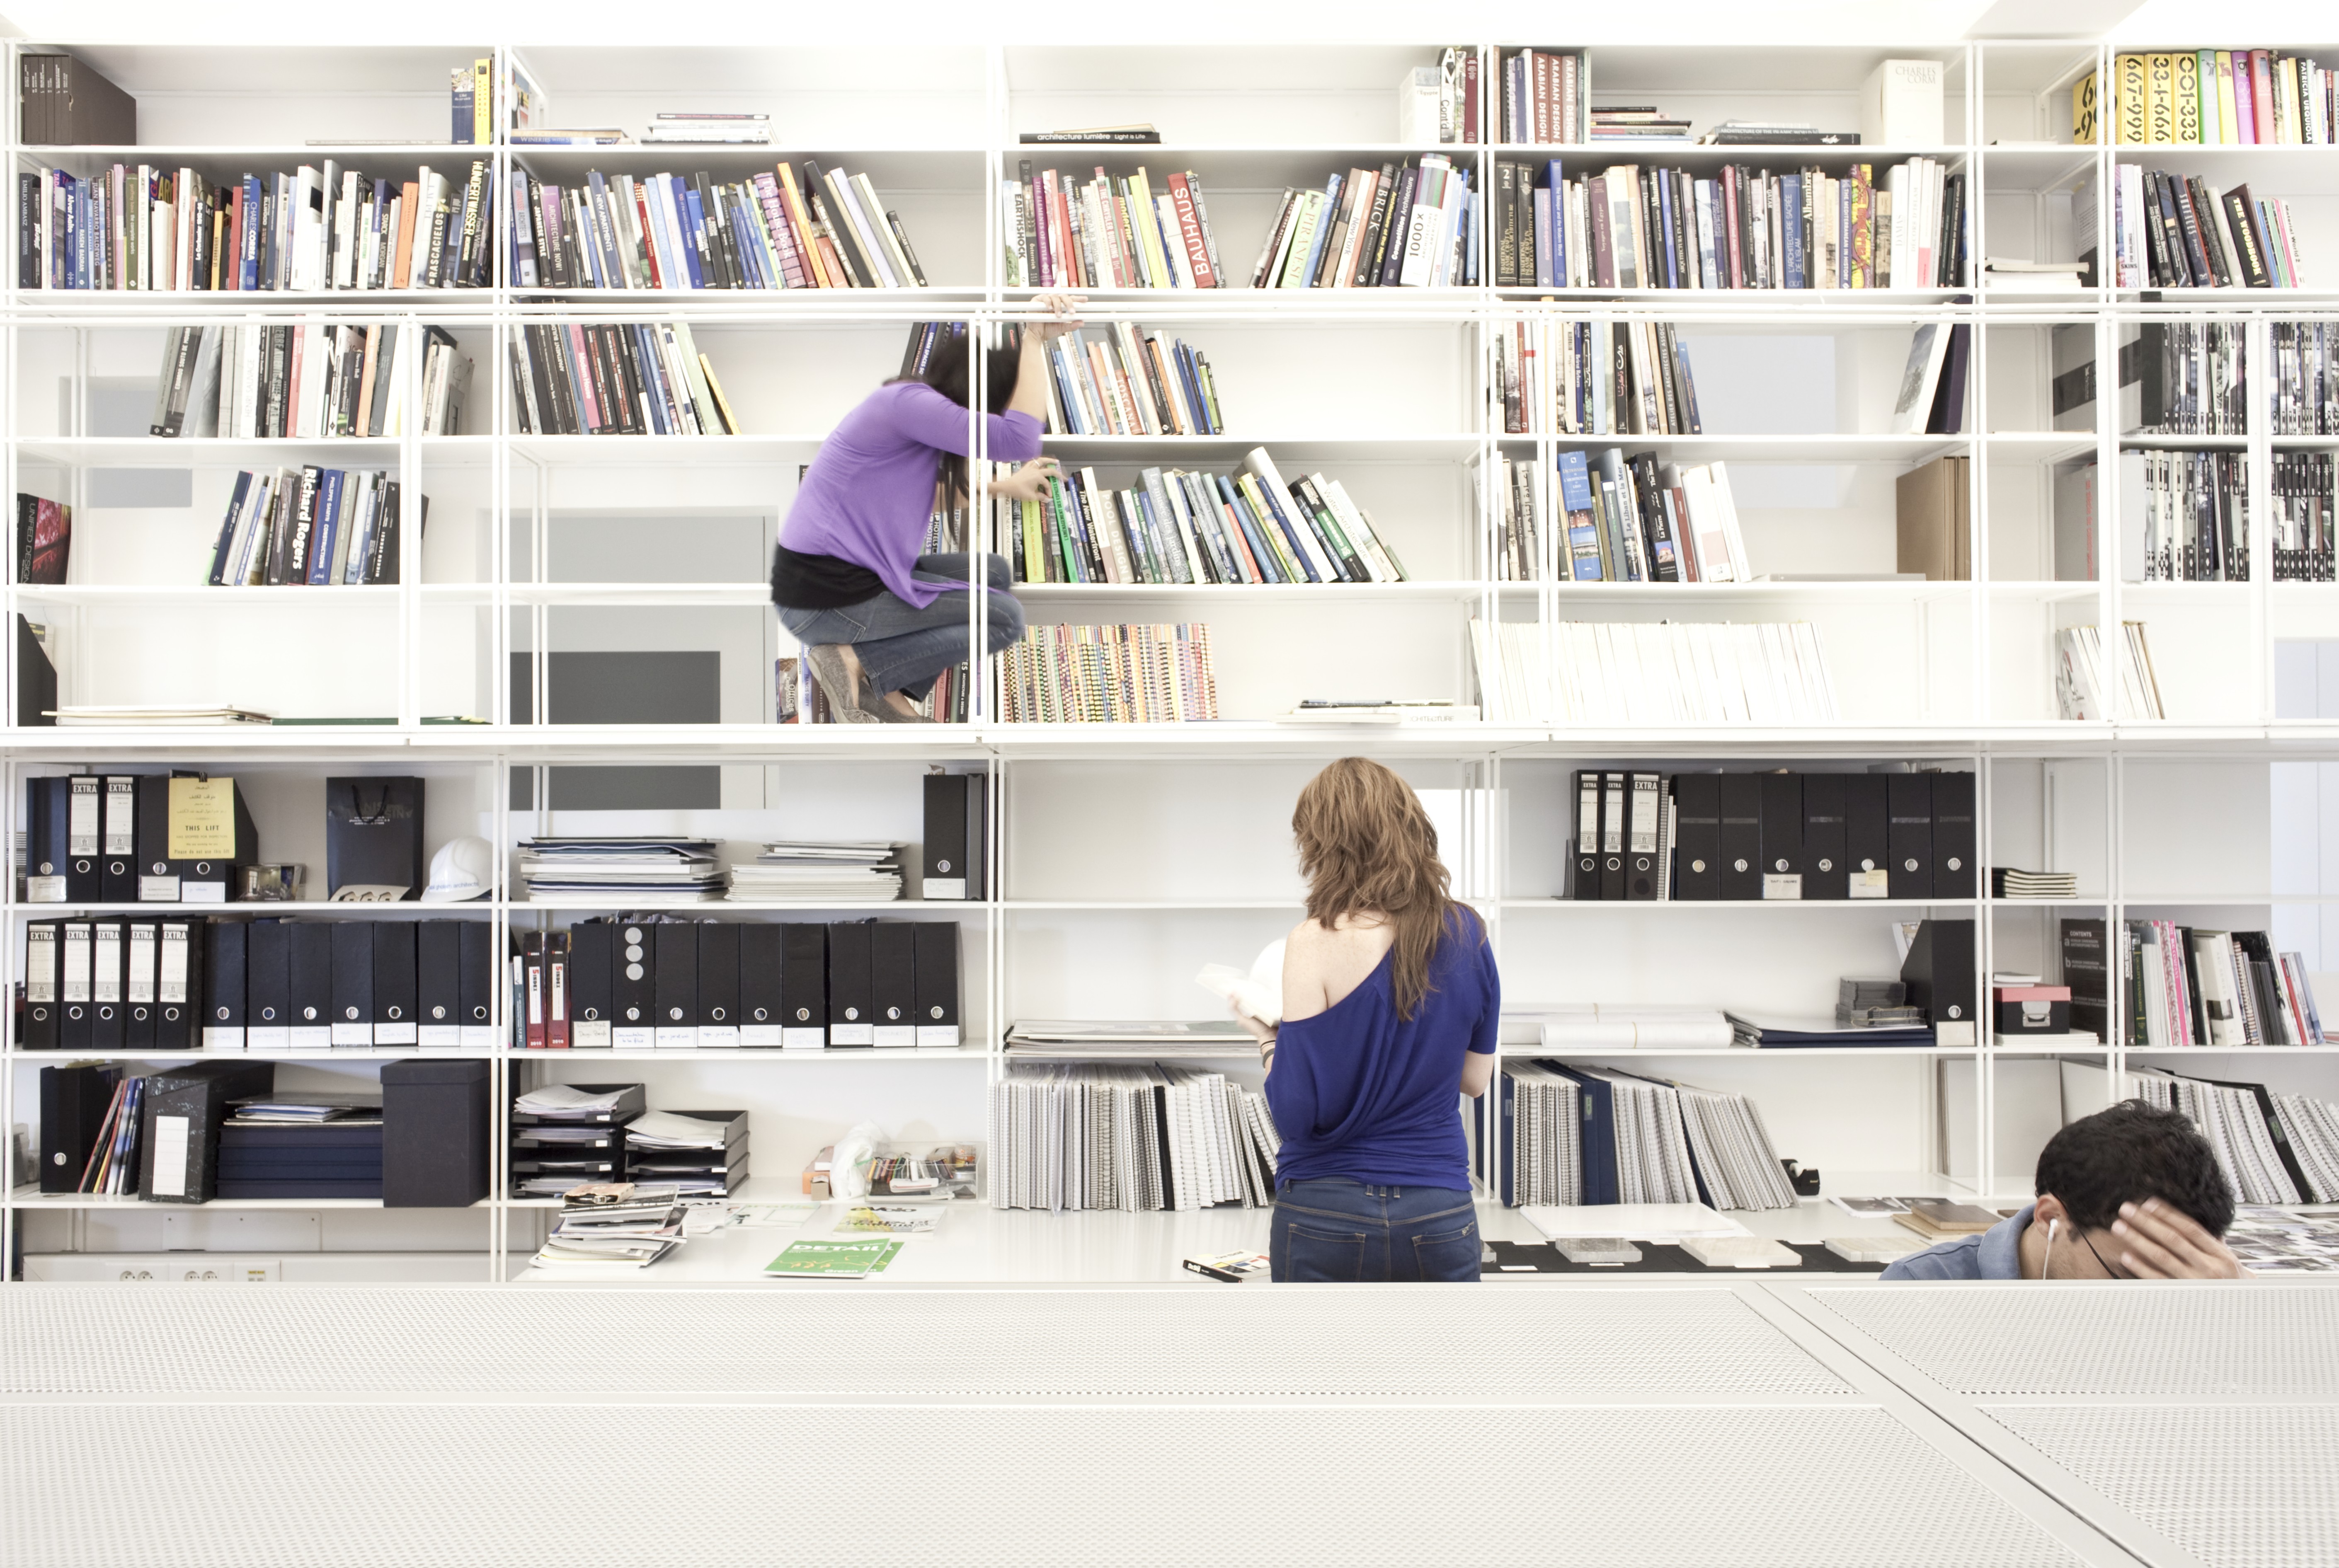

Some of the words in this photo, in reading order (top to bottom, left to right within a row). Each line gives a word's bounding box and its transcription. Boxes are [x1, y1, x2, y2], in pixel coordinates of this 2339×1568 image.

[1895, 66, 1936, 75] CHARLES
[1908, 75, 1936, 84] CORM
[2126, 58, 2143, 142] 667-999
[2153, 57, 2170, 141] 334-666
[2179, 57, 2197, 140] 001-333
[1539, 102, 1547, 137] DESIGN
[2303, 99, 2312, 142] URQUIOLA
[464, 161, 484, 235] HUNDERTWASSER
[595, 194, 604, 210] NEW
[1099, 188, 1108, 199] THE
[1369, 189, 1388, 231] BRICK
[1384, 191, 1397, 229] Architecture
[1650, 172, 1660, 208] Alhambra
[1802, 172, 1812, 221] Alhambra
[534, 206, 544, 237] JAPANESE
[599, 211, 613, 252] APARTMENTS
[763, 177, 774, 198] The
[771, 199, 784, 231] House
[779, 233, 793, 259] Book
[1015, 194, 1026, 259] EARTHSHOCK
[1036, 196, 1045, 228] ELEMENTS
[1101, 200, 1113, 231] CHRYSLER
[1118, 197, 1134, 241] moderne
[1174, 187, 1209, 276] BAUHAUS
[1351, 217, 1360, 235] New
[1391, 216, 1406, 260] Competition
[1401, 177, 1414, 215] Architecture
[2285, 205, 2294, 235] Material
[429, 213, 444, 278] RASCACIELOS
[472, 235, 480, 259] Williams
[548, 205, 560, 252] ARCHITECTURE
[554, 254, 562, 271] NOW!
[818, 206, 828, 220] Mies
[828, 230, 837, 239] der
[833, 239, 844, 254] Rohe
[842, 261, 852, 275] work
[1107, 232, 1118, 259] BUILDING
[1197, 204, 1206, 221] DECO
[1202, 222, 1217, 264] ARCHITECTURE
[1289, 213, 1315, 279] PIRANESI
[1344, 235, 1355, 256] York
[2201, 198, 2214, 229] Natural
[2209, 231, 2225, 270] Surfaces
[2233, 198, 2245, 218] THE
[2240, 220, 2262, 276] WOODBOOK
[1376, 247, 1385, 263] Night
[578, 352, 587, 377] Modern
[583, 378, 591, 399] House
[1117, 377, 1137, 428] TOSCANA
[298, 468, 318, 522] Richard
[327, 477, 335, 502] PHILIPPE
[1071, 484, 1079, 510] Waterfront
[1149, 473, 1159, 486] Le
[1154, 488, 1168, 512] musée
[1163, 515, 1176, 535] des
[26, 503, 36, 543] UNIFIED
[1082, 505, 1091, 520] New
[1087, 522, 1101, 561] Waterfront
[1103, 494, 1115, 525] POOL
[1113, 531, 1129, 574] DESIGN
[23, 545, 32, 583] DESIGN
[292, 522, 310, 570] Rogers
[318, 524, 329, 569] CONSTRUCTIONS
[73, 784, 97, 794] EXTRA
[108, 784, 132, 793] EXTRA
[1635, 781, 1658, 790] EXTRA
[30, 931, 54, 941] EXTRA
[66, 930, 89, 940] EXTRA
[97, 930, 120, 940] EXTRA
[132, 930, 154, 940] EXTRA
[163, 930, 187, 940] EXTRA
